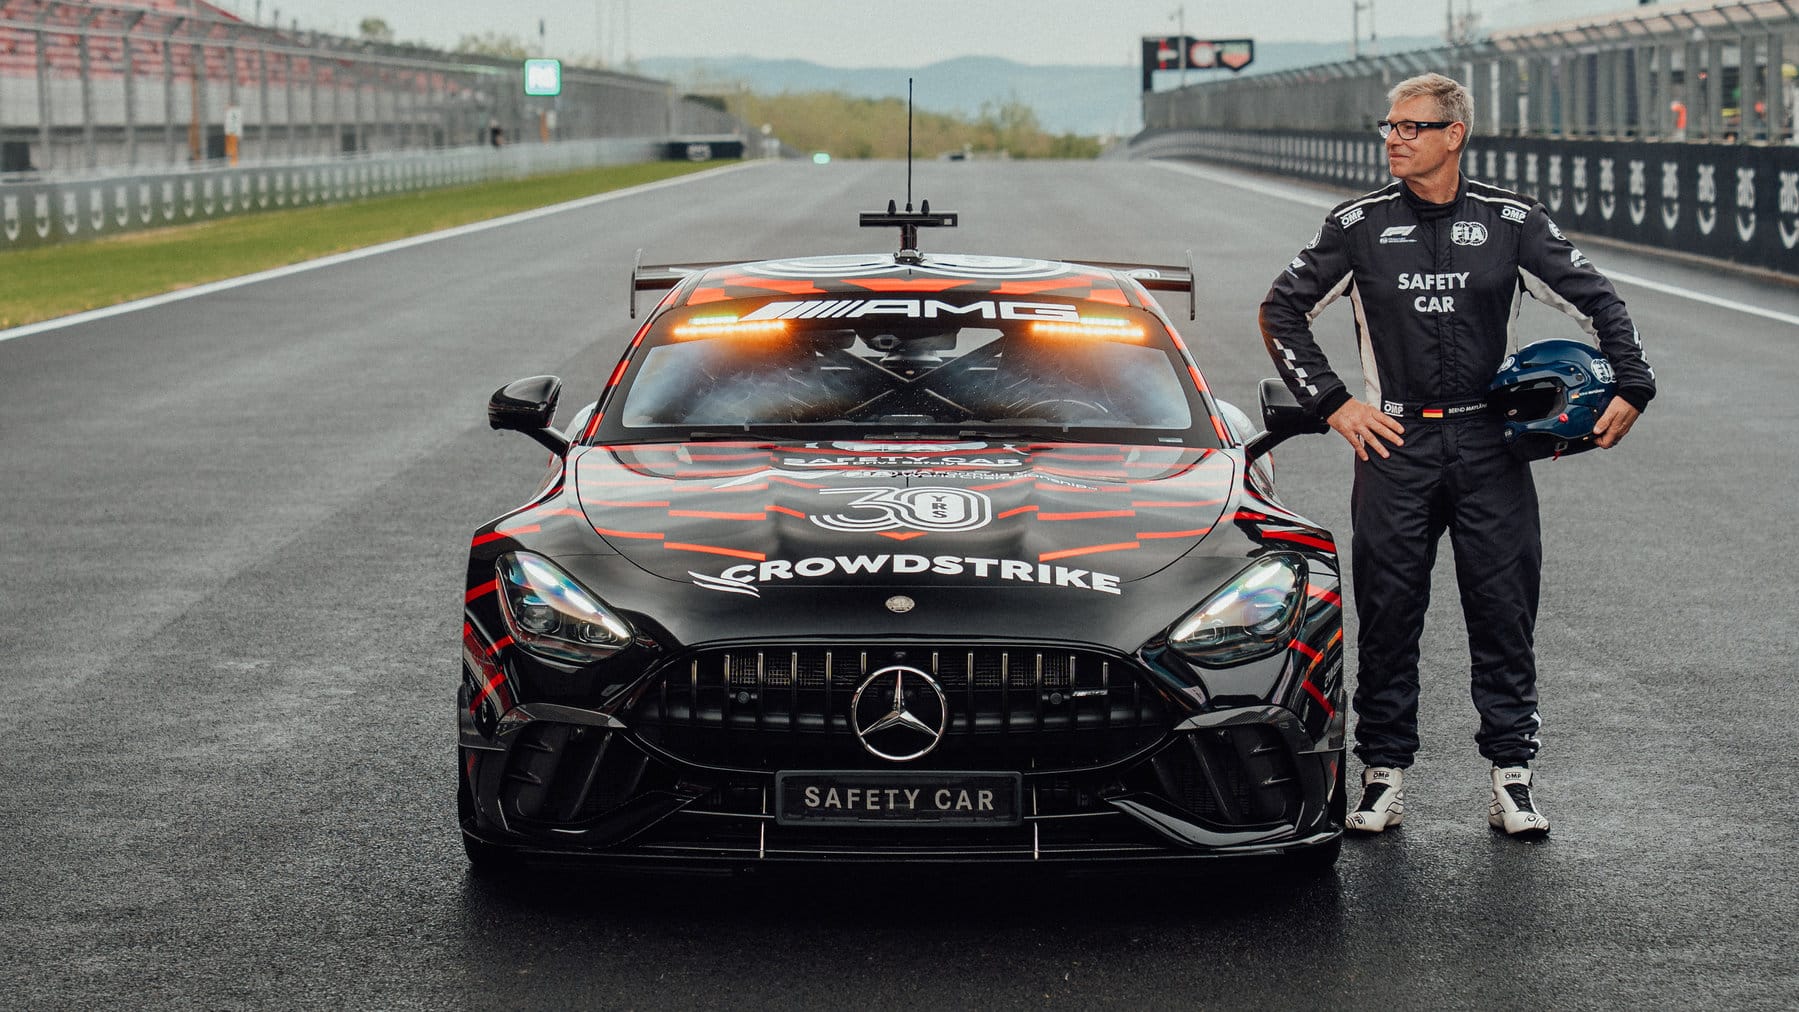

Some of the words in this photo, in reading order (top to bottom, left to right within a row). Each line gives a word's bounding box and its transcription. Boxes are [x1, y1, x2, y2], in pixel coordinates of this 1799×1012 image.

[1341, 209, 1363, 226] OMP
[1502, 208, 1526, 221] OMP
[1452, 222, 1486, 244] FIA
[1398, 272, 1470, 290] SAFETY
[847, 299, 1080, 322] AMG
[1414, 296, 1455, 313] CAR
[1384, 403, 1404, 414] OMP
[784, 456, 930, 465] SAFETY
[940, 456, 1022, 465] CAR
[809, 486, 992, 532] 30
[719, 554, 1122, 595] CROWDSTRIKE
[804, 786, 921, 810] SAFETY
[934, 788, 994, 811] CAR
